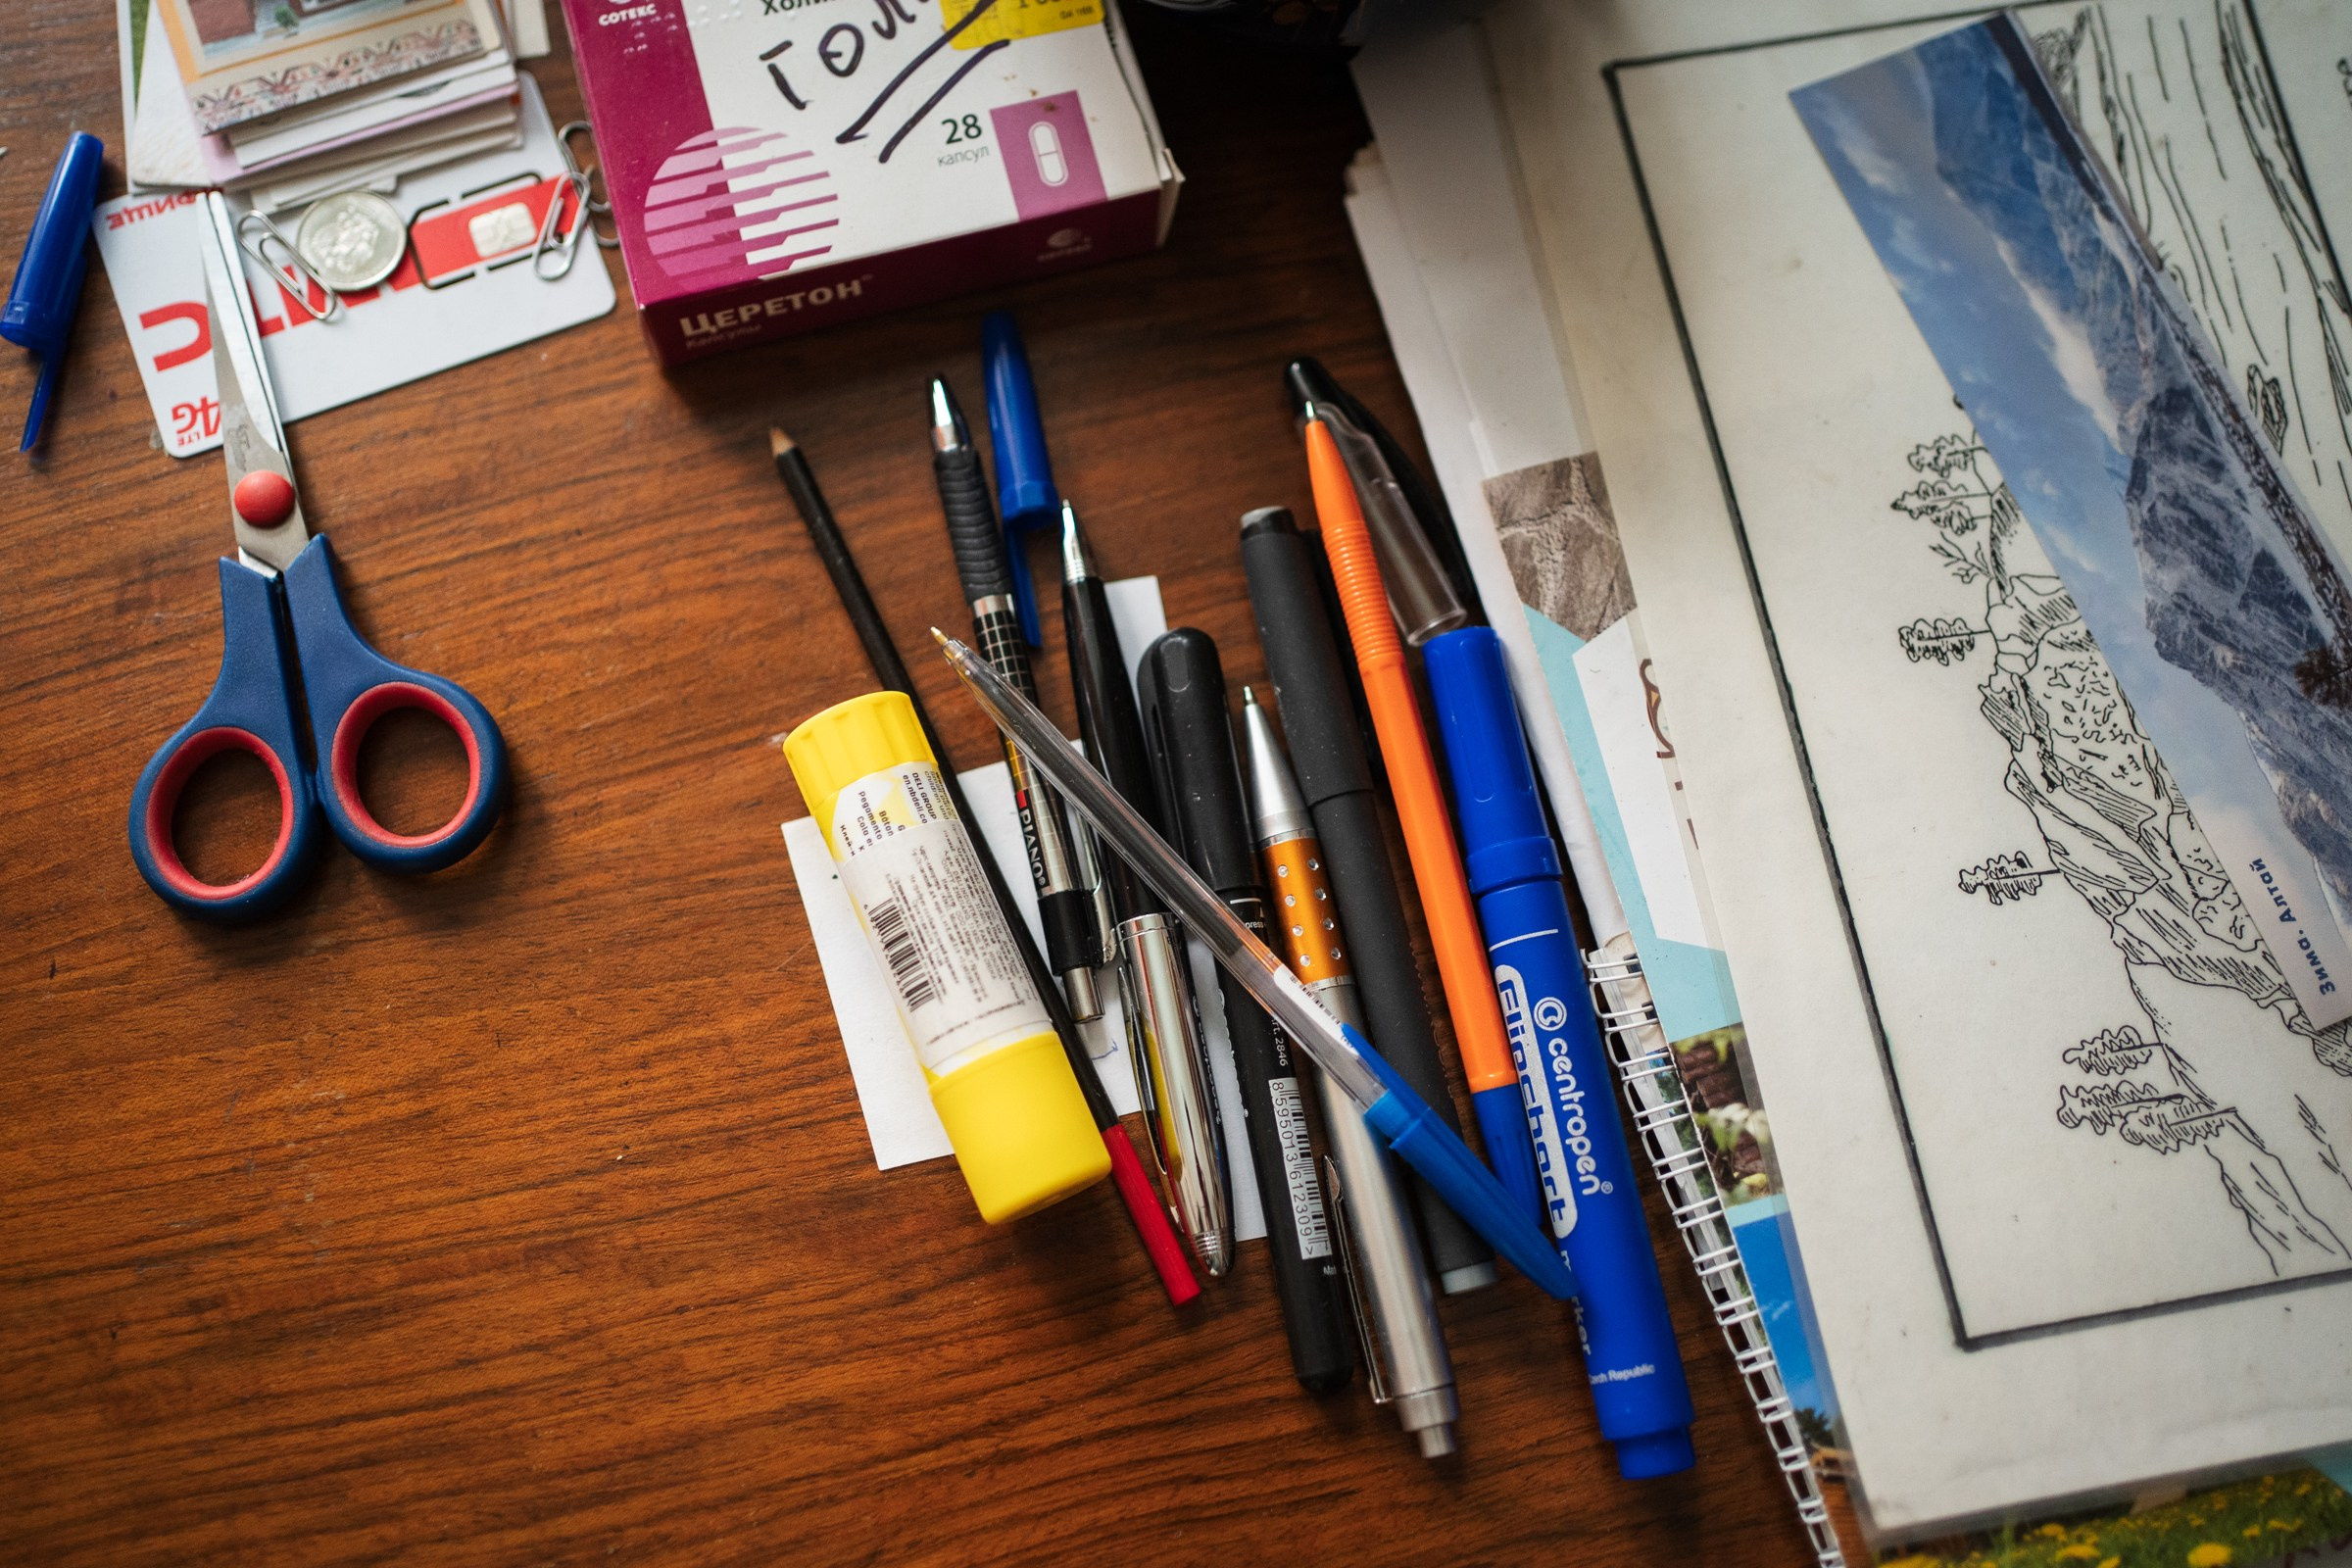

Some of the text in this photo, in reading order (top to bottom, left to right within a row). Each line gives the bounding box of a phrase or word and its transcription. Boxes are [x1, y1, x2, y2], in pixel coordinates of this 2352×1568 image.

[599, 4, 657, 26] СОТЕКС
[941, 114, 983, 145] 28
[937, 145, 990, 168] капсул
[106, 188, 198, 231] ФИЩЕ
[679, 279, 863, 337] ЦЕРЕТОН
[172, 396, 222, 438] 4G
[176, 431, 202, 447] LTE
[858, 791, 883, 840] Pegamento
[912, 772, 937, 820] DELI GROUP
[857, 816, 869, 837] Cola
[1019, 808, 1044, 879] PIANO
[2249, 858, 2336, 996] Зима. Алтай
[1275, 1037, 1289, 1067] 2846
[1498, 978, 1566, 1224] Flipchart
[1548, 1037, 1601, 1196] centropen
[1560, 1250, 1592, 1356] mrker
